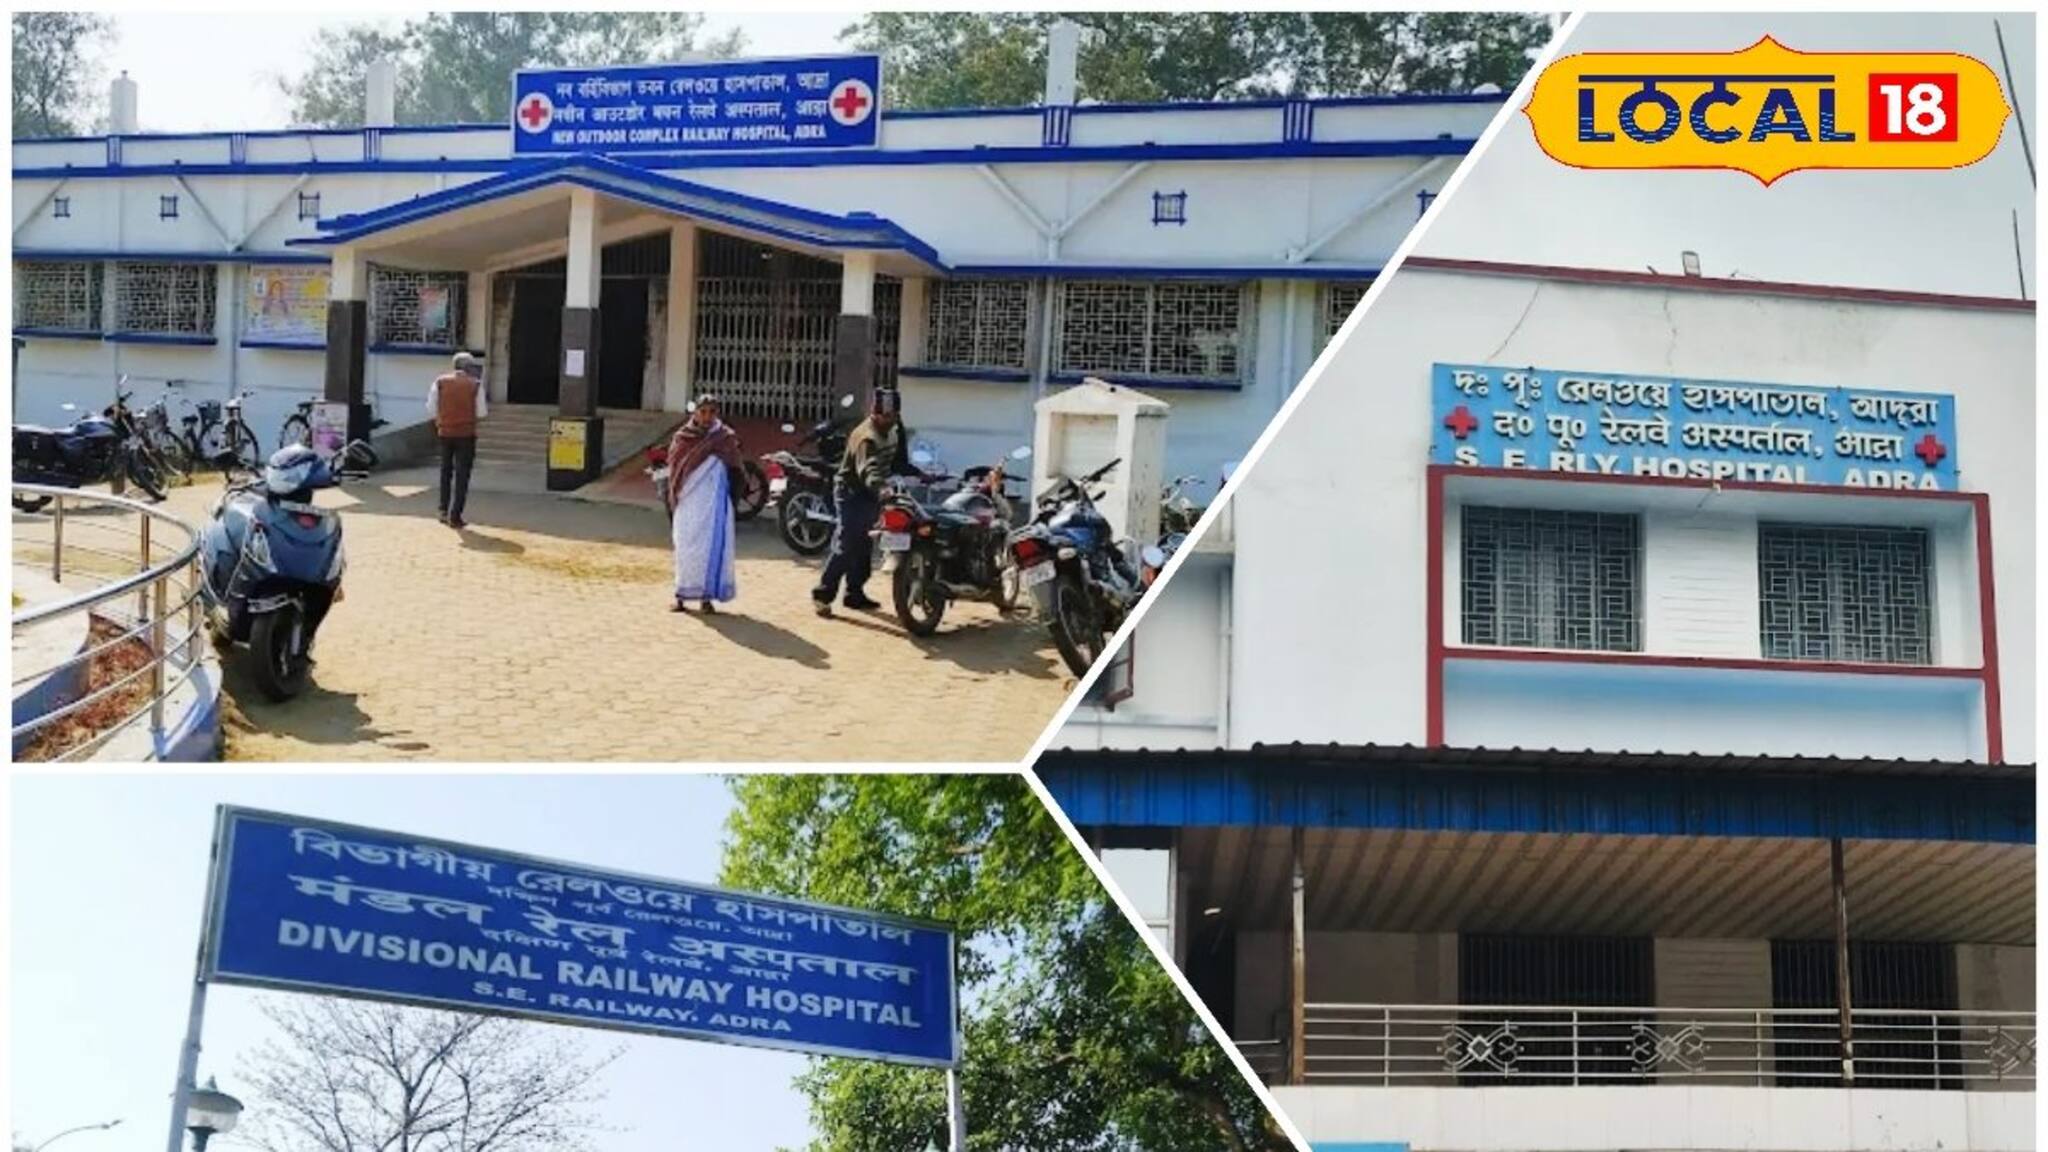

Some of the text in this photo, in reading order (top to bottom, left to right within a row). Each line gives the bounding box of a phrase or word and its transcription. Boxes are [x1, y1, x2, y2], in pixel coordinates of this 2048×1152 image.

[552, 124, 827, 144] NEW OUTDOOR COMPLEX RAILWAY HOSPITAL, ADRA
[1600, 407, 1671, 445] रेलवे
[1844, 468, 1940, 492] ADRA
[287, 874, 918, 986] मंडल रेल अस्पताल
[713, 897, 914, 946] হাসপাতাল
[278, 918, 921, 1028] DIVISIONAL RAILWAY HOSPITAL
[708, 1013, 792, 1032] ADRA
